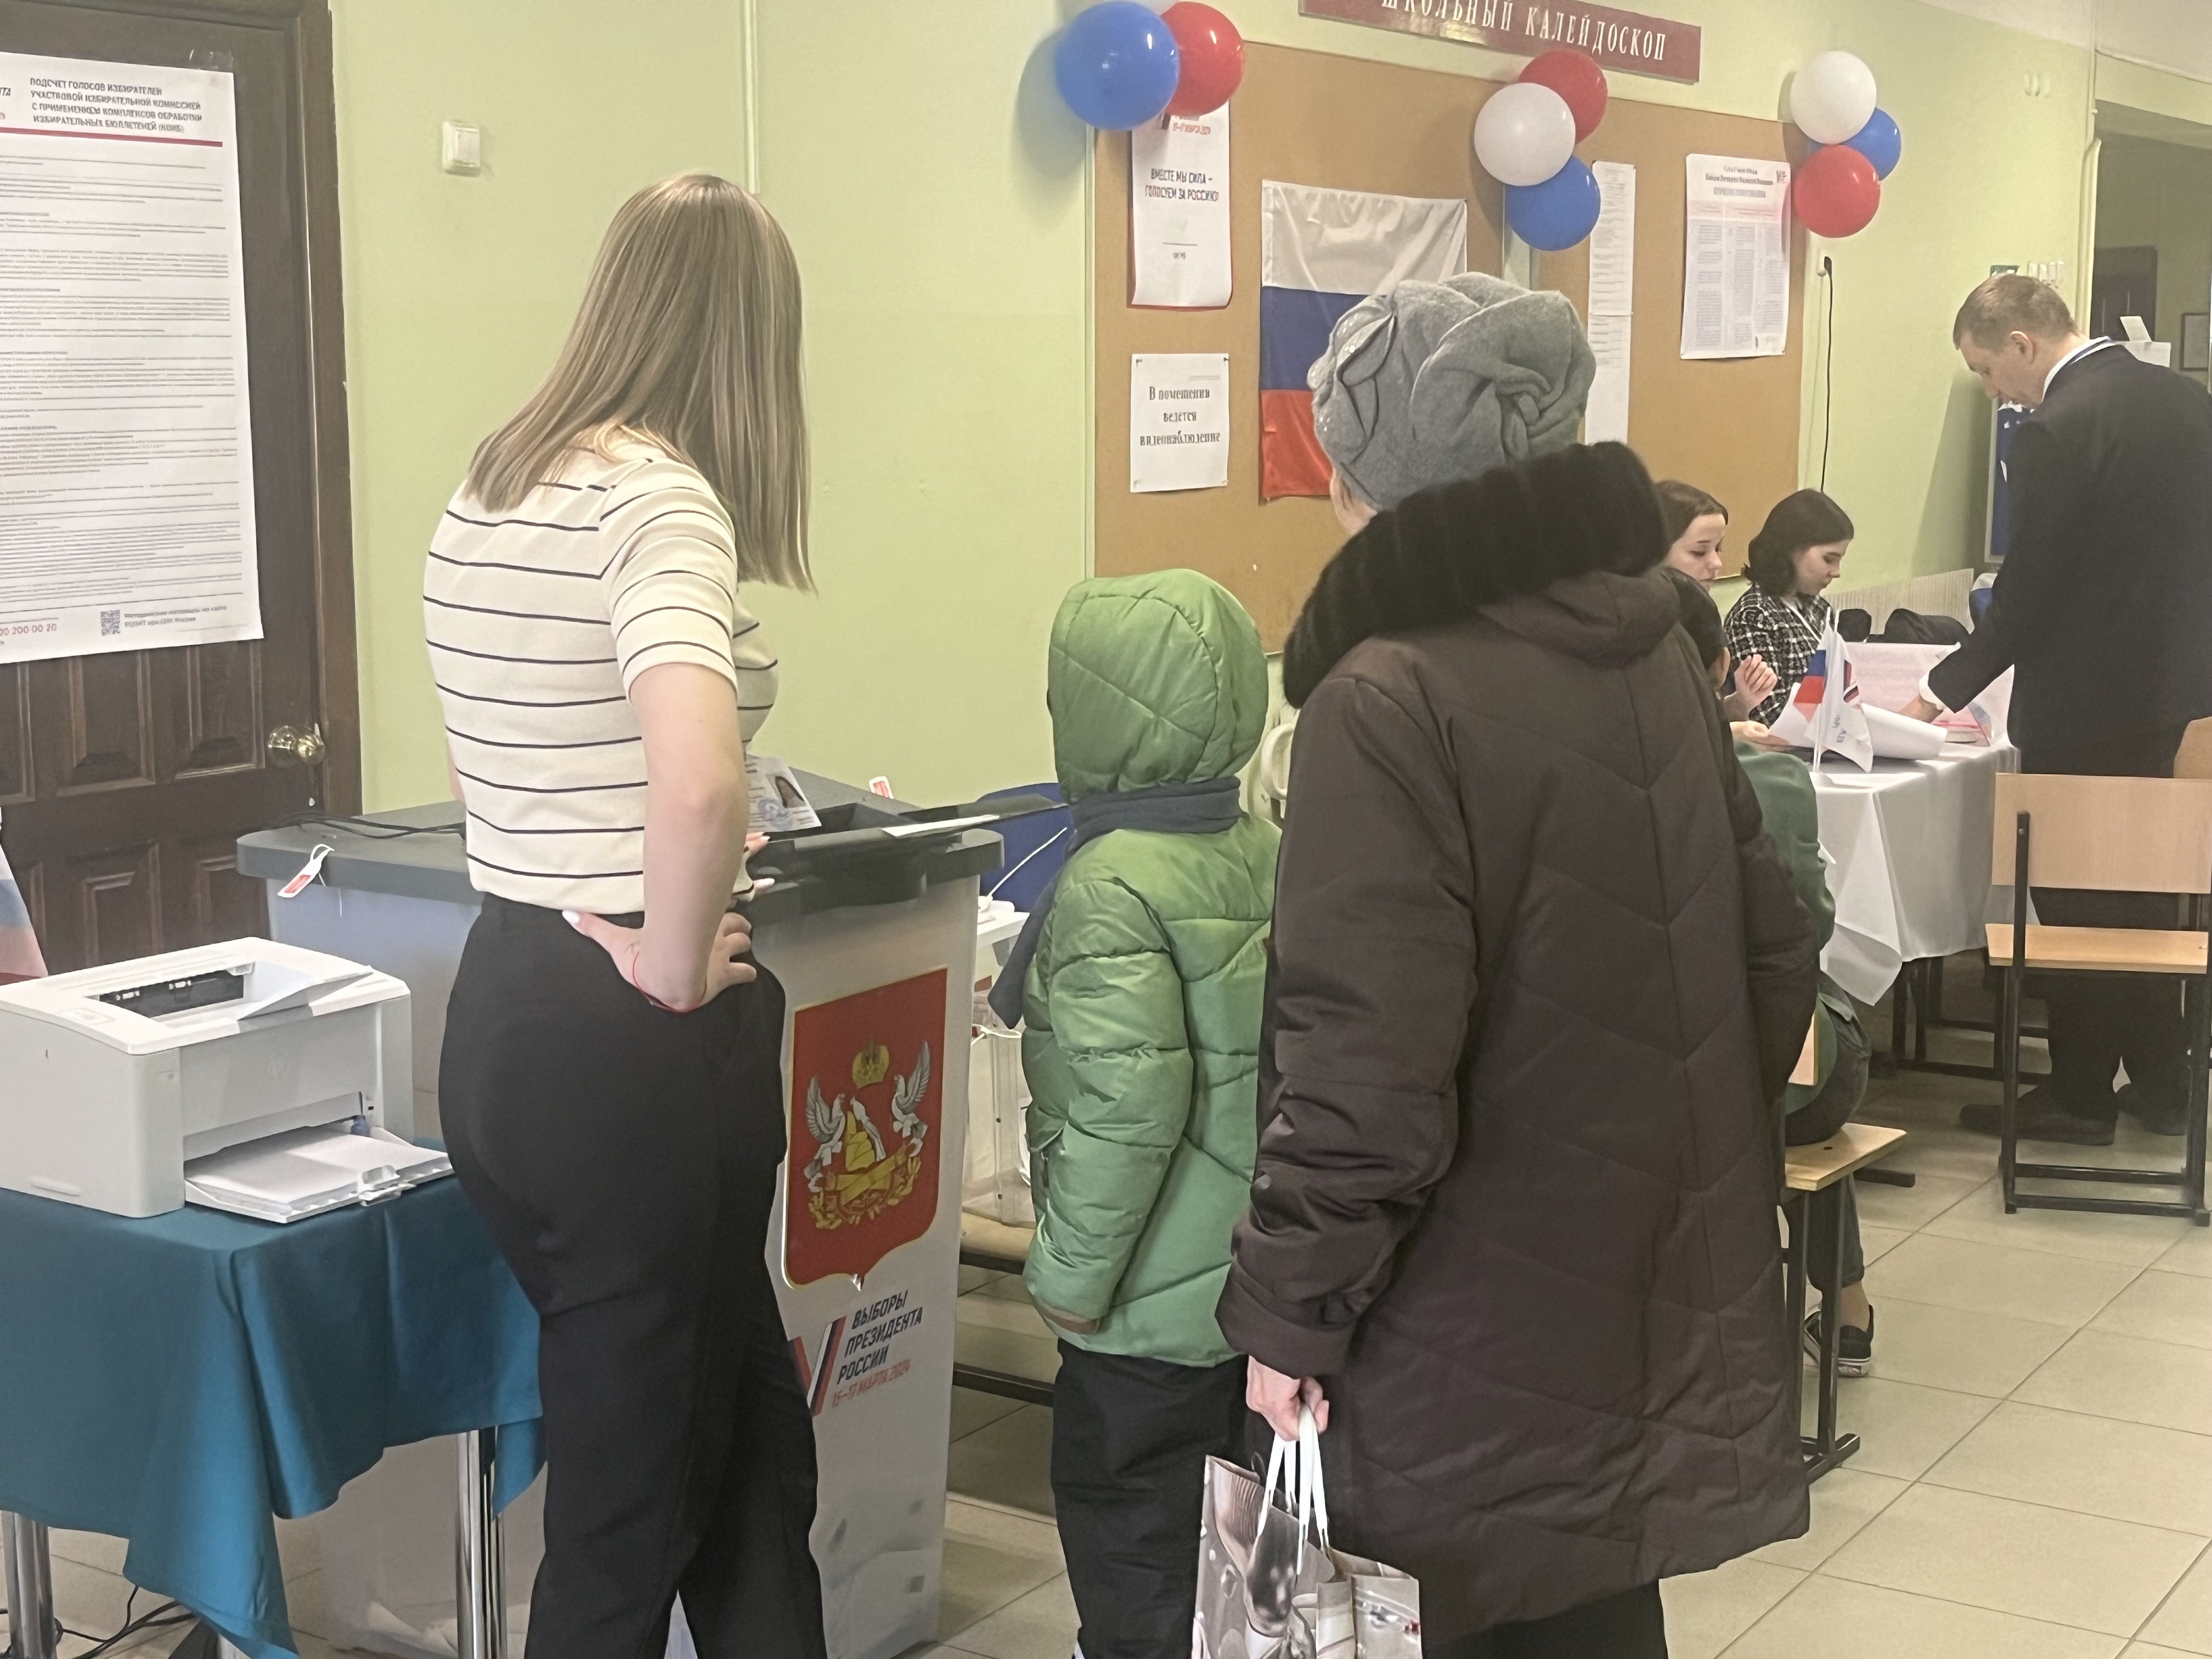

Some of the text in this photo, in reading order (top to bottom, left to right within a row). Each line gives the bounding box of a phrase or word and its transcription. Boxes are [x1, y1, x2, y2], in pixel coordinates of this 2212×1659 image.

[1525, 7, 1666, 60] КАЛЕЙДОСКОП
[69, 81, 105, 91] ГОЛОСОВ
[85, 95, 151, 106] ИЗБИРАТЕЛЬНОЙ
[1149, 386, 1210, 400] В помещении
[1140, 430, 1221, 446] видеонаблюдение
[12, 626, 29, 635] 200
[32, 624, 43, 633] 00
[46, 623, 57, 631] 20
[851, 1290, 909, 1330] ВЫБОРЫ
[845, 1306, 923, 1358] ПРЕЗИДЕНТА
[837, 1345, 889, 1385] РОССИИ
